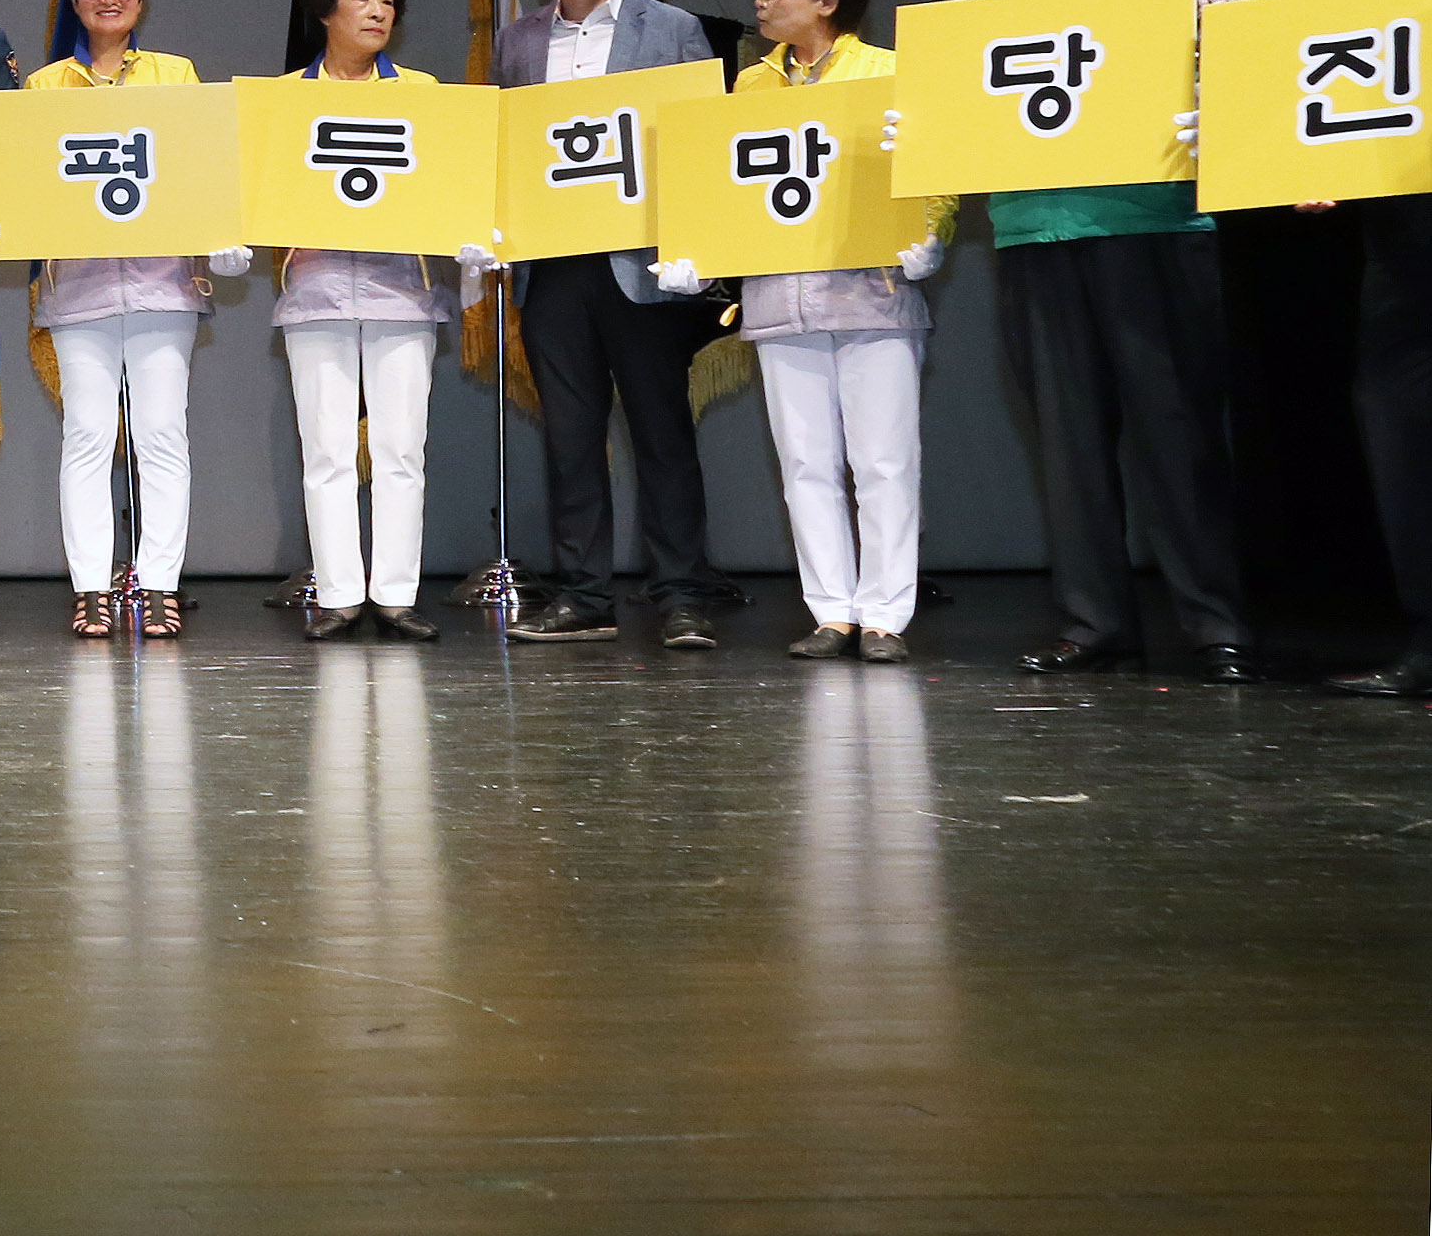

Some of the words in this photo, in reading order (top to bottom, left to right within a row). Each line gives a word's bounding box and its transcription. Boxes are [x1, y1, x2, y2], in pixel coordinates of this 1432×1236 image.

[990, 32, 1096, 131] 당
[1305, 26, 1414, 137] 진
[64, 133, 149, 216] 평
[311, 121, 410, 202] 등
[551, 113, 638, 198] 희
[736, 127, 831, 219] 망
